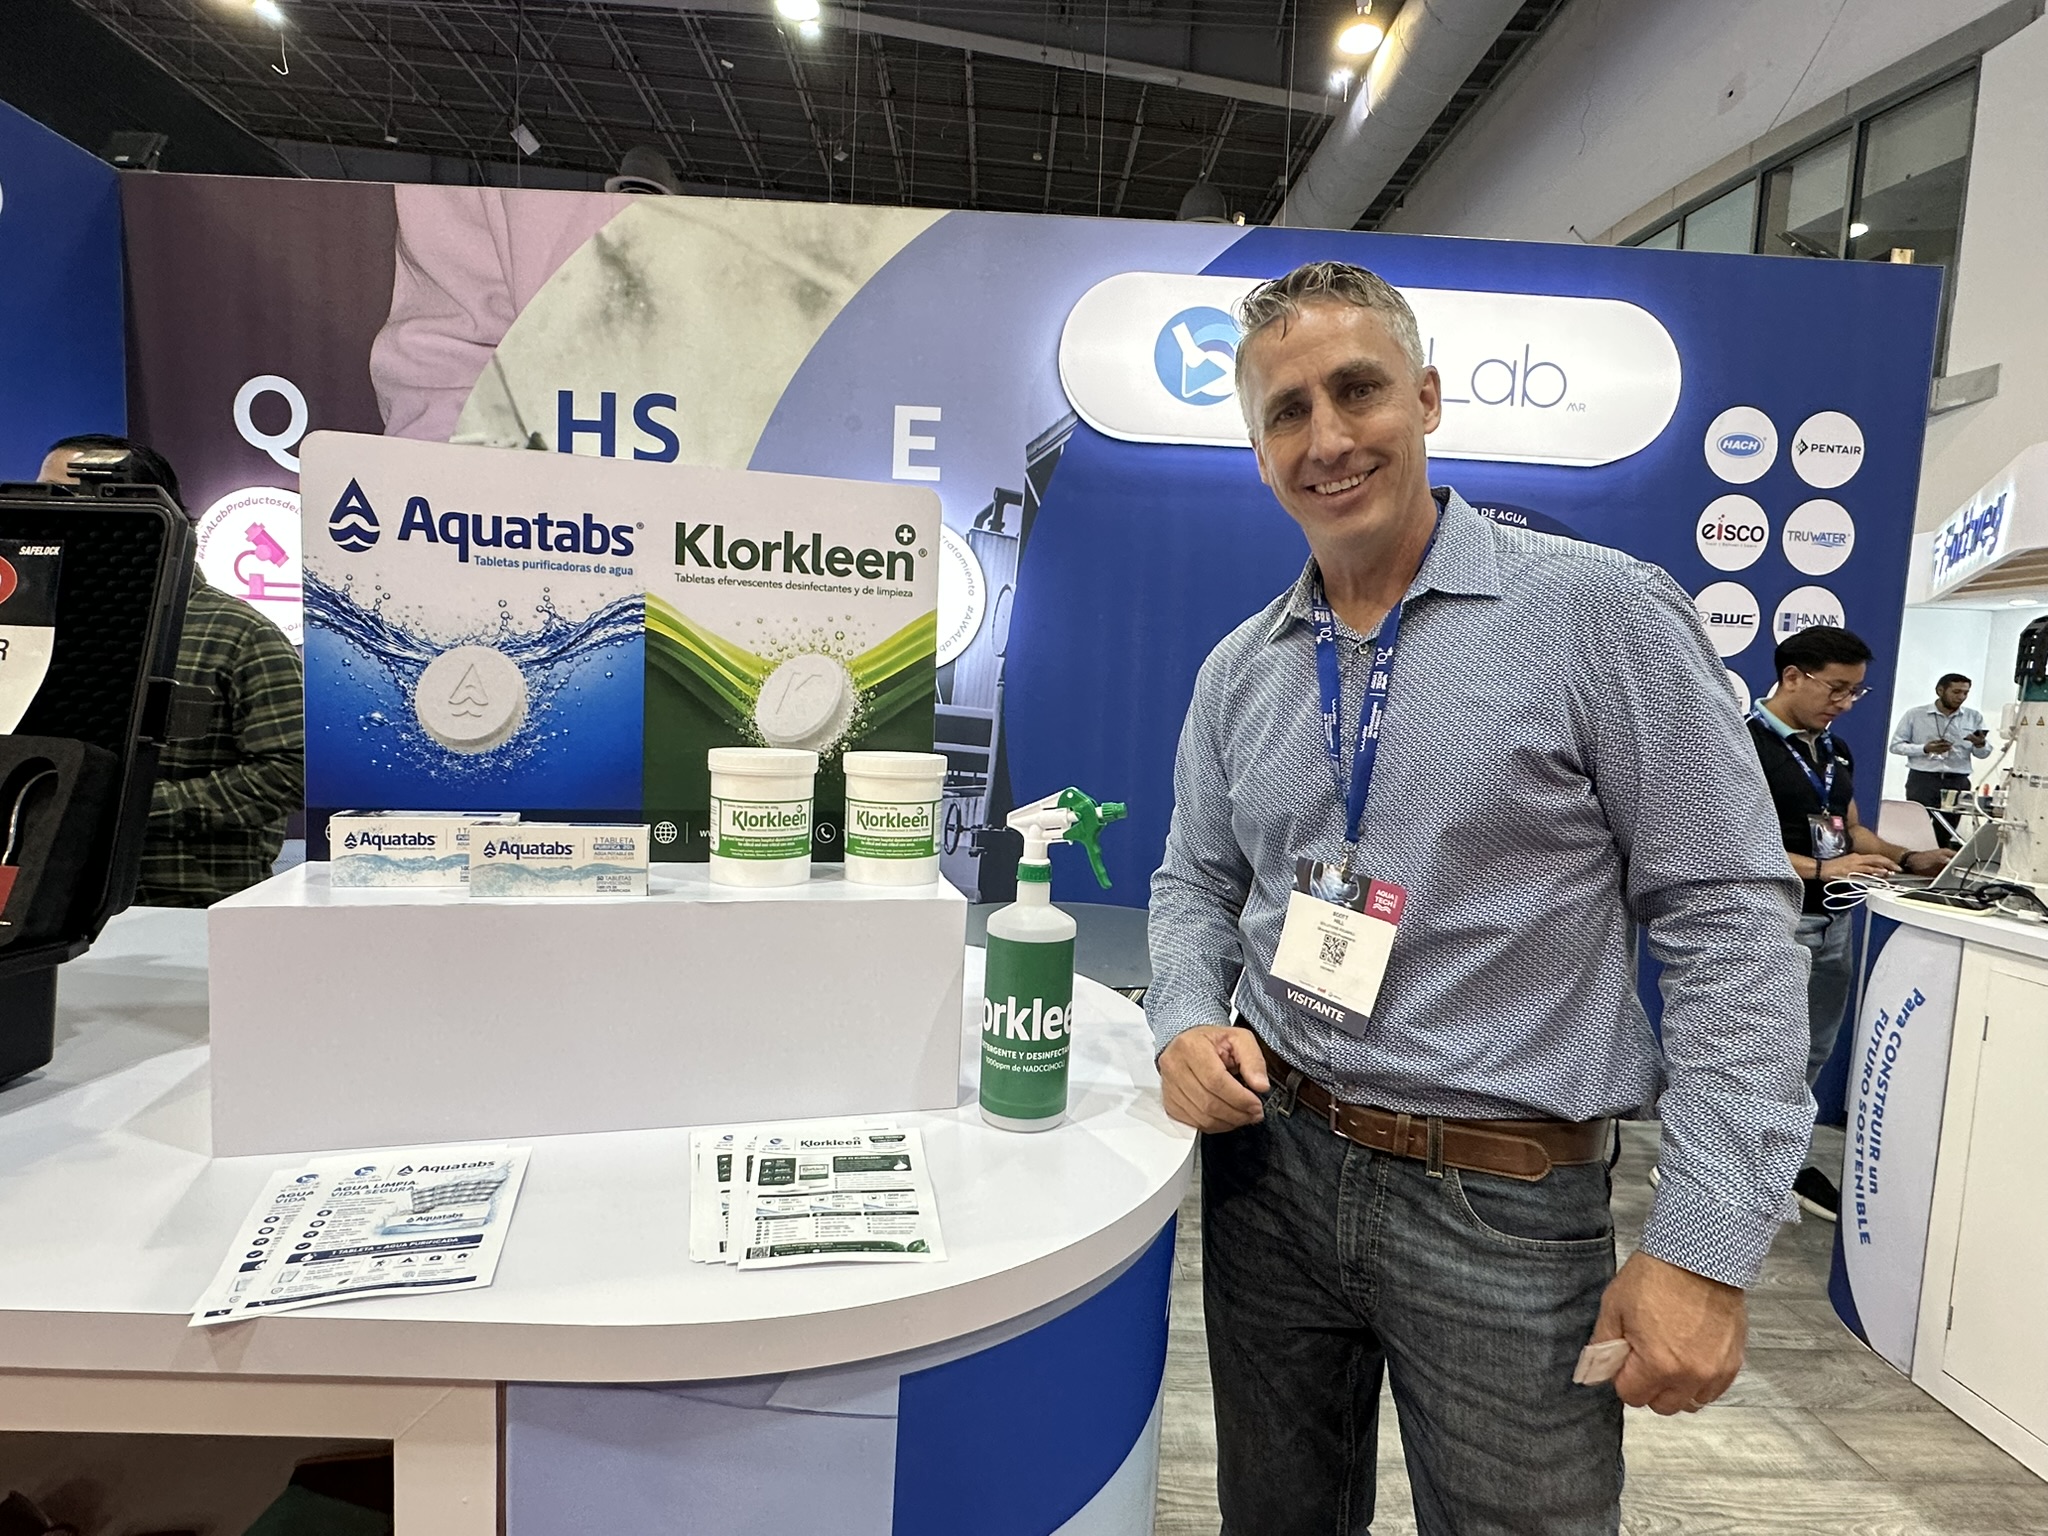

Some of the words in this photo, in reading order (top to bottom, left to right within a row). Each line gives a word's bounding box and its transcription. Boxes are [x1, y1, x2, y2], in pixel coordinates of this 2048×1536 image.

[233, 374, 309, 474] Q
[557, 389, 681, 464] HS
[892, 404, 942, 482] E
[1722, 439, 1760, 451] HACH
[1810, 443, 1862, 455] PENTAIR
[1481, 507, 1497, 518] DE
[1496, 510, 1528, 527] AGUA
[1701, 520, 1765, 542] eisco
[18, 546, 61, 556] SAFELOCK
[474, 555, 520, 569] Tabletas
[522, 558, 592, 574] purificadoras
[593, 563, 607, 574] de
[608, 566, 634, 577] agua
[674, 573, 716, 585] Tabletas
[717, 577, 783, 590] efervescentes
[785, 580, 852, 594] desinfectantes
[854, 587, 860, 596] y
[862, 585, 874, 596] de
[876, 586, 914, 599] limpieza
[1796, 612, 1840, 627] HANNA
[732, 809, 807, 831] Klorkleen
[856, 809, 929, 831] Klorkleen
[360, 832, 437, 851] Aquatabs
[599, 836, 635, 844] TABLETA
[498, 841, 574, 860] Aquatabs
[1374, 895, 1394, 908] TECH
[1376, 889, 1395, 900] AQUA
[1286, 987, 1346, 1023] VISITANTE
[1895, 987, 1927, 1029] Para
[1019, 1051, 1025, 1060] Y
[1860, 1008, 1890, 1096] FUTURO
[1011, 1064, 1021, 1073] de
[1868, 1030, 1902, 1162] CONSTRUIR
[800, 1139, 862, 1147] Klorkleen
[417, 1160, 496, 1174] Aquatabs
[1854, 1097, 1872, 1246] SOSTENIBLE
[333, 1184, 370, 1192] AGUA
[1868, 1165, 1879, 1195] un
[276, 1190, 315, 1199] AGUA
[331, 1190, 361, 1198] VIDA
[414, 1212, 465, 1223] Aquatabs
[338, 1246, 375, 1255] TABLETA
[383, 1242, 408, 1250] AGUA
[408, 1237, 459, 1246] PURIFICADA
